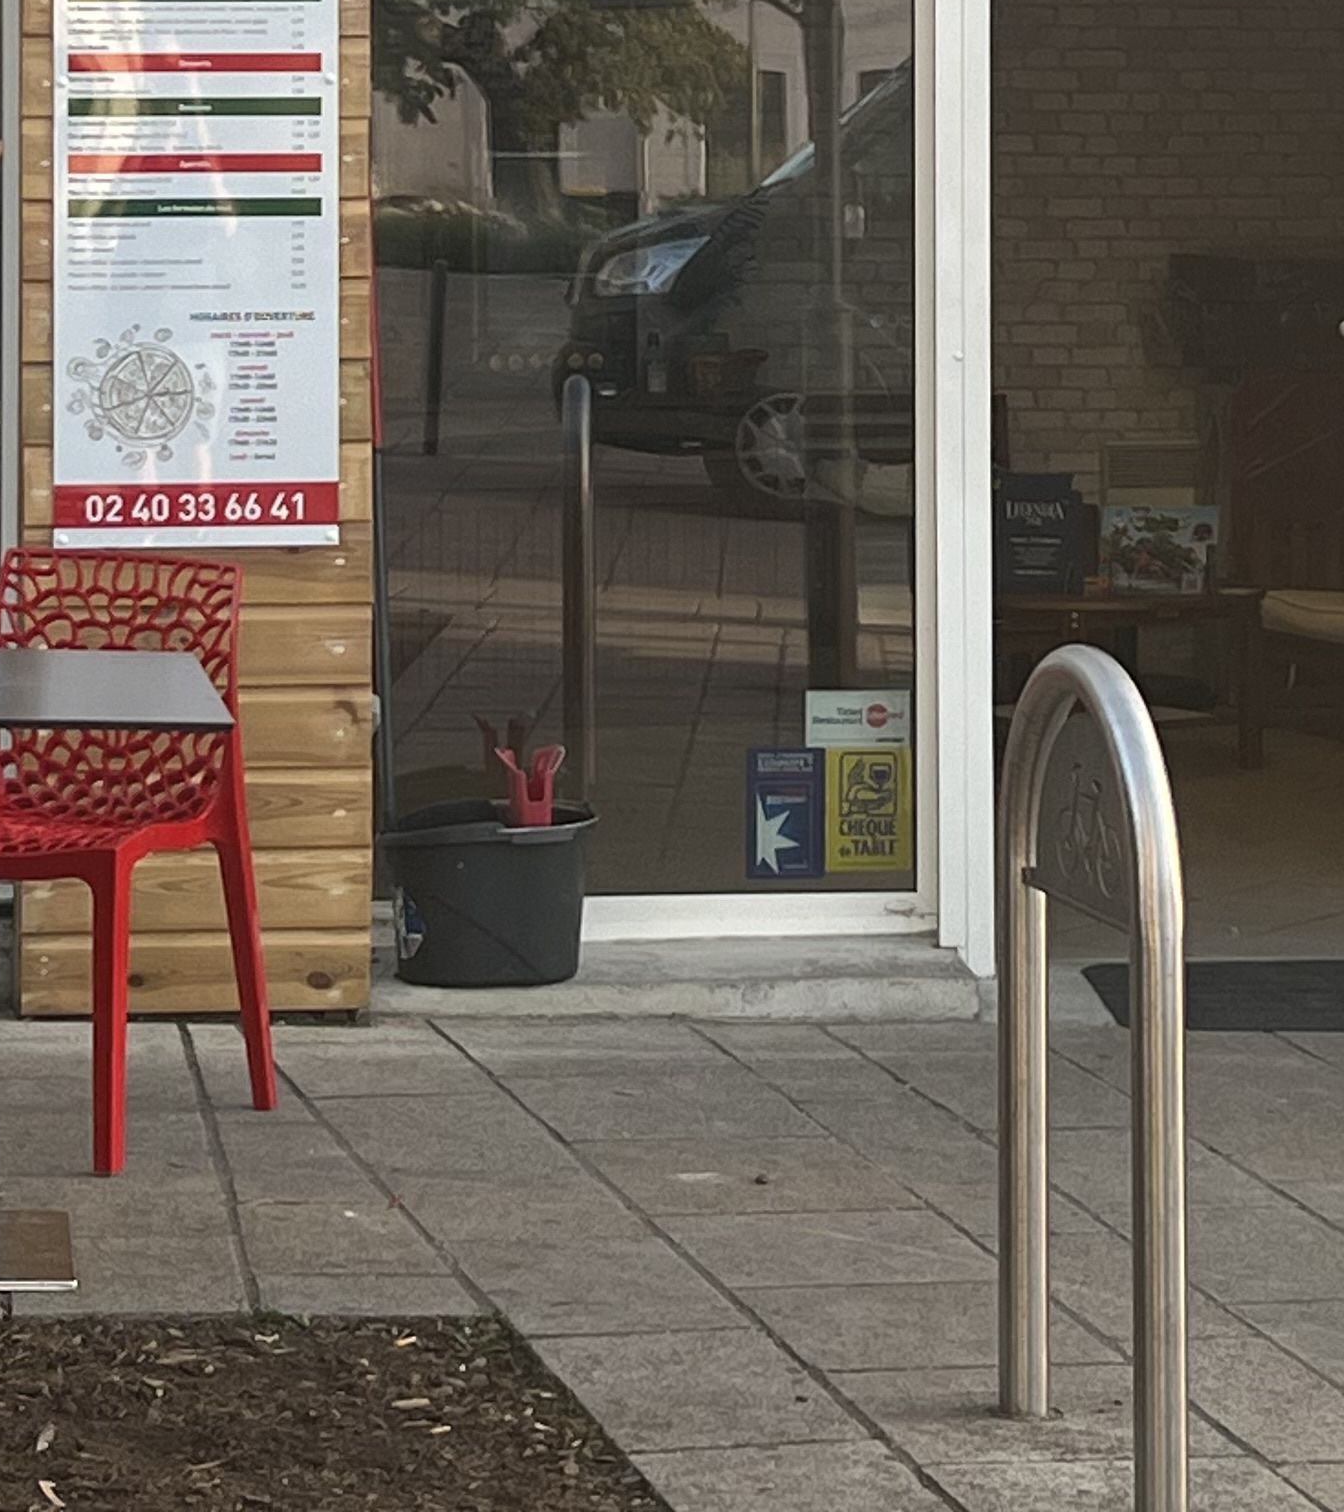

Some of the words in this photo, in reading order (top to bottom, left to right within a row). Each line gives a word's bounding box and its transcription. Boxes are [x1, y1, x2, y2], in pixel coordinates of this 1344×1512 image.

[84, 494, 124, 523] 02
[131, 494, 170, 523] 40
[178, 493, 216, 522] 33
[225, 493, 262, 522] 66
[270, 492, 305, 522] 41
